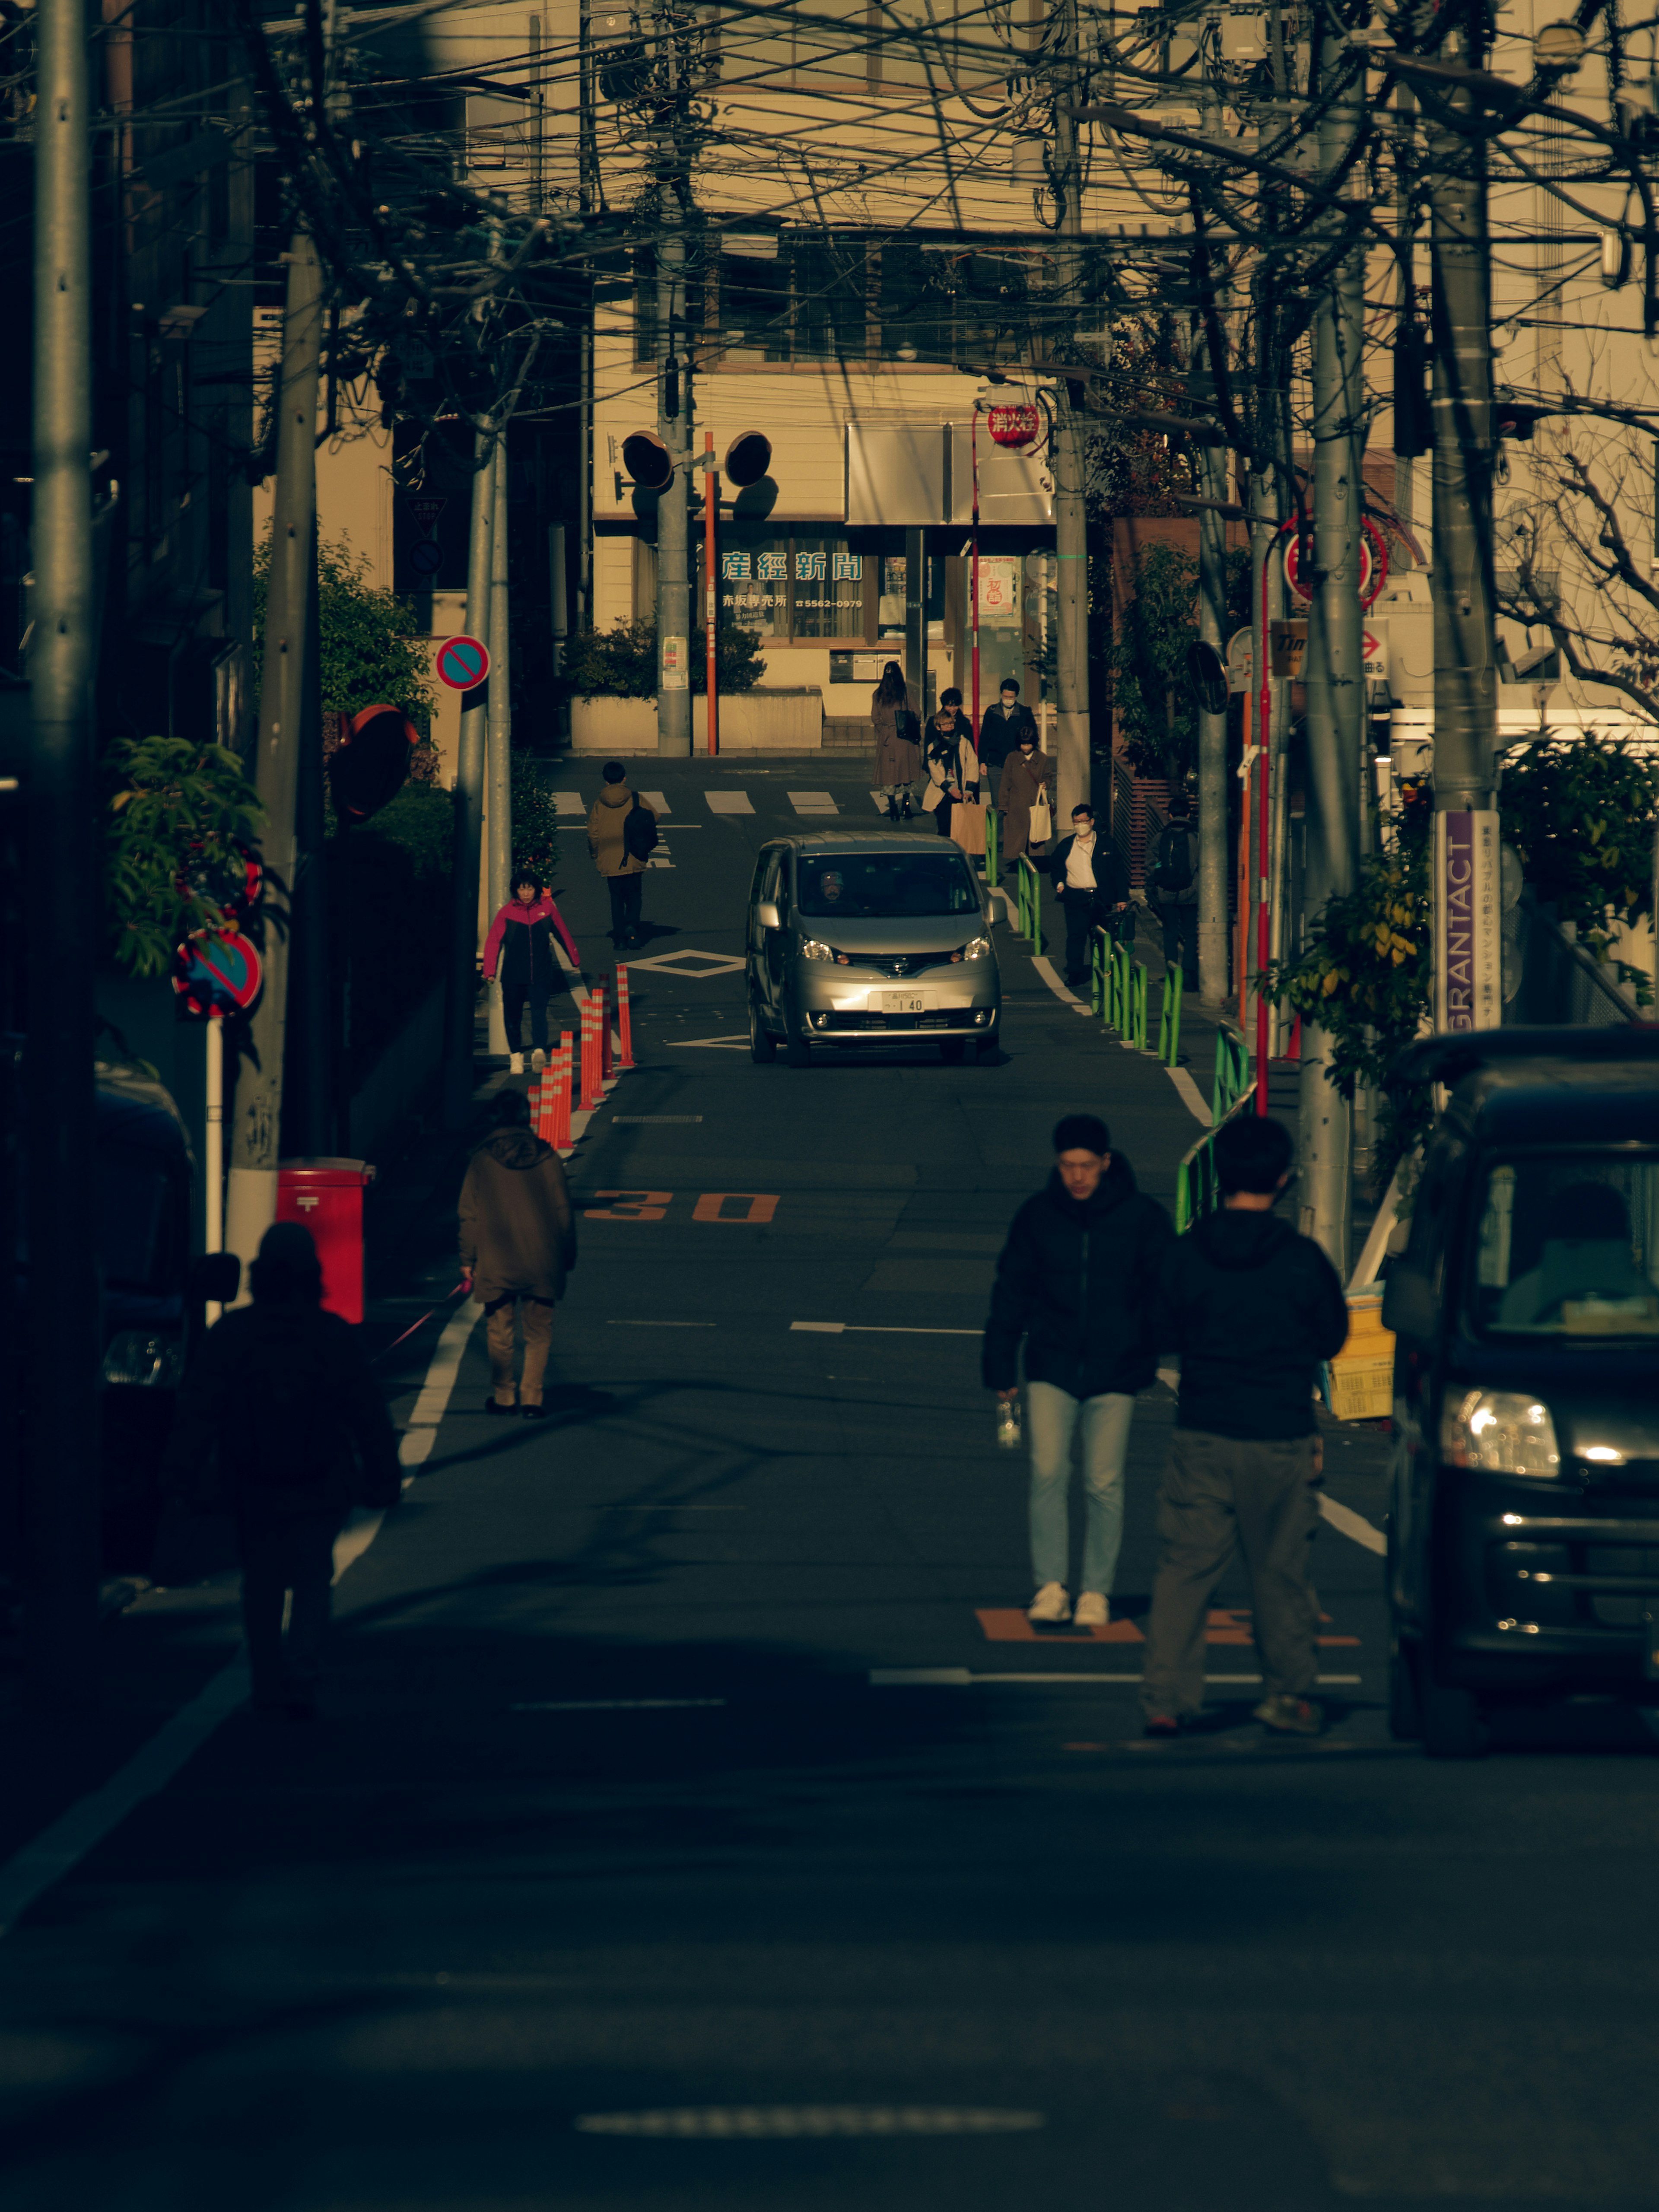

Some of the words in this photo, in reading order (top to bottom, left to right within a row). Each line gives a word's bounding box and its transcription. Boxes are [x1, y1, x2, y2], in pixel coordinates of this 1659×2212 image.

[992, 411, 1037, 432] 消火栓
[414, 502, 439, 511] 止まれ
[722, 551, 863, 581] 産經新聞
[722, 594, 787, 607] 赤坂専売所
[804, 599, 863, 608] 5562-0979
[1448, 836, 1472, 1031] GRANTACT
[583, 1190, 781, 1223] 30
